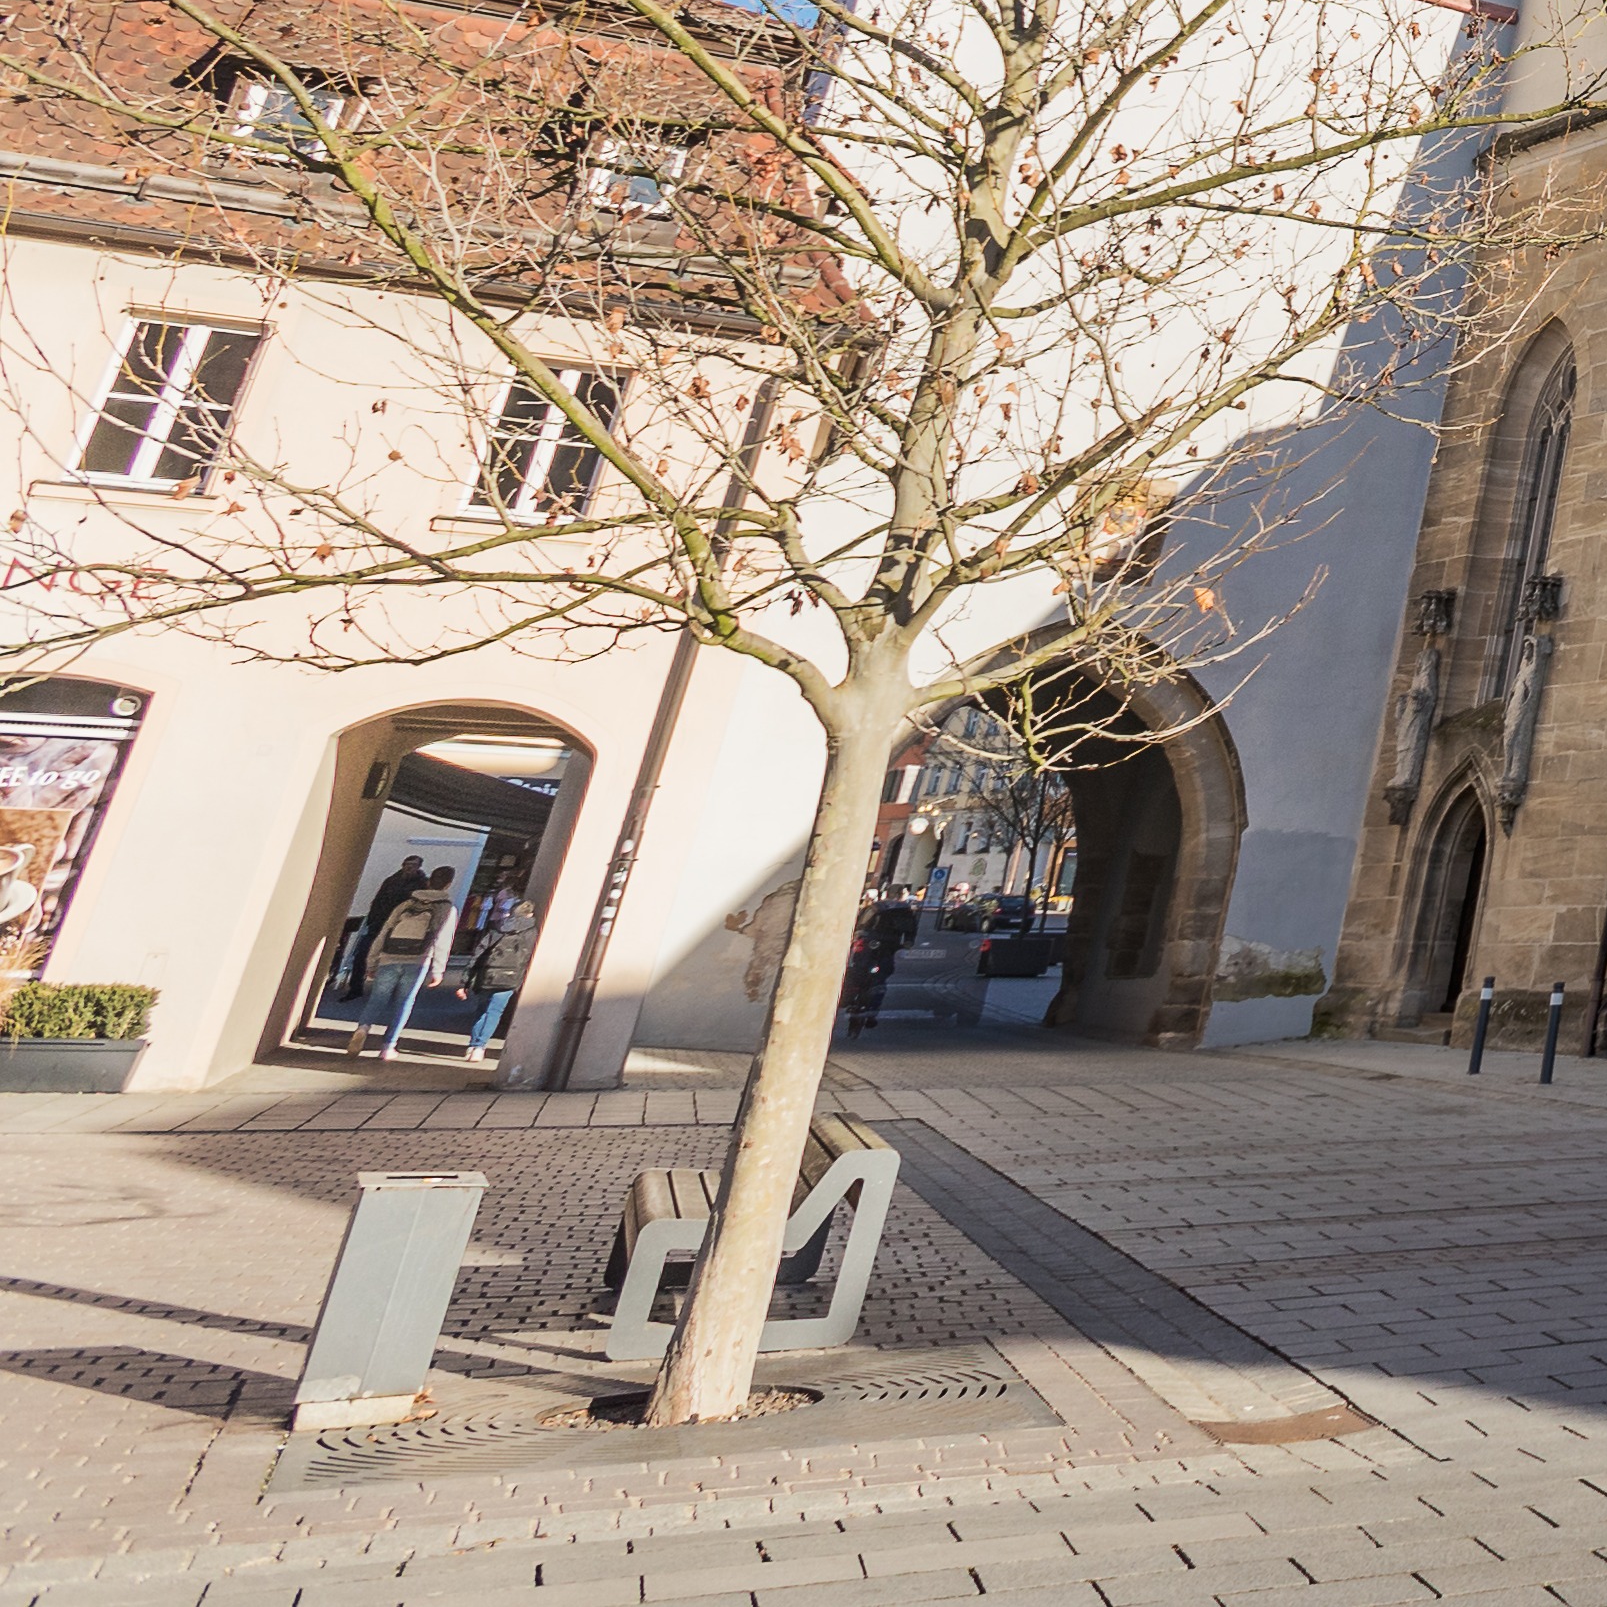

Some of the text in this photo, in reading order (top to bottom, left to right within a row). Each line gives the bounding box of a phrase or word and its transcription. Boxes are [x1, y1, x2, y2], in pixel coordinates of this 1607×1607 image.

[0, 766, 101, 790] EE to go
